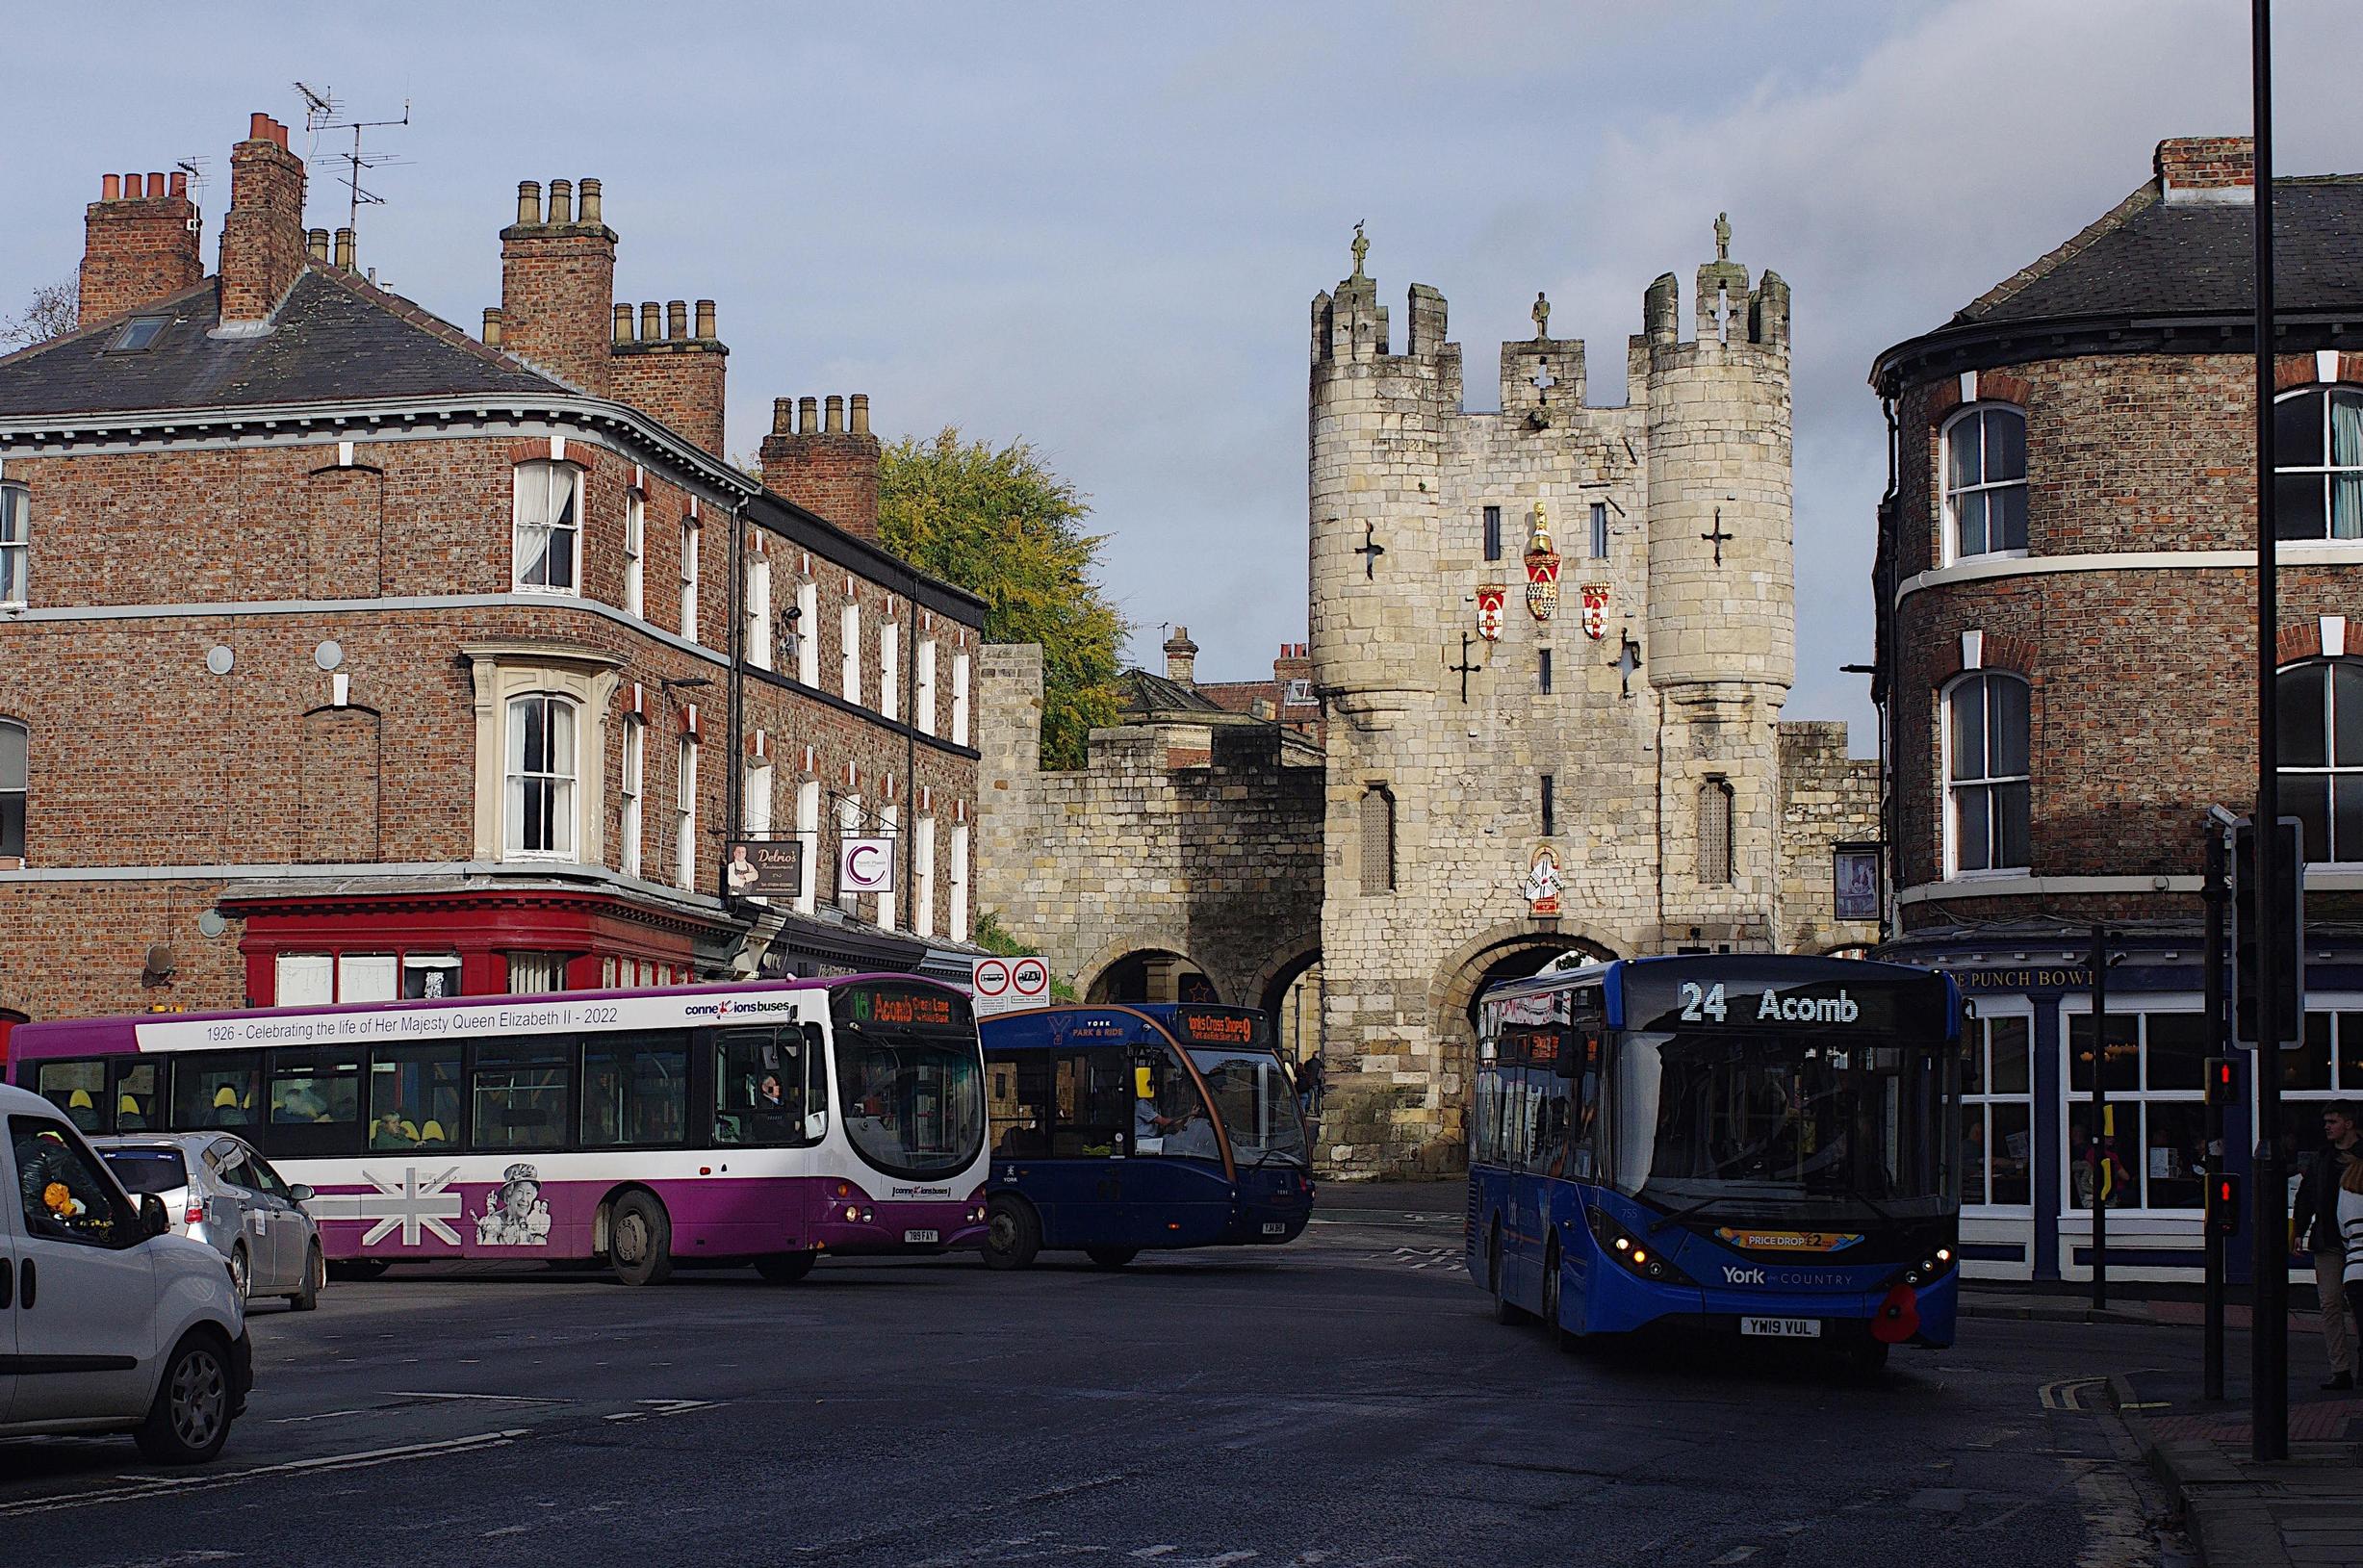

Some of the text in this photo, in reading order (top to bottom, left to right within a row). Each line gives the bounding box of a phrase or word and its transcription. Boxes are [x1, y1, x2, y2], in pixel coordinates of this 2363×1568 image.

[758, 848, 797, 862] Delrio's
[1971, 971, 2030, 987] PUNCH
[855, 991, 912, 1022] 16 Acomb
[1681, 982, 1859, 1022] 24 Acomb
[207, 1026, 235, 1041] 1926
[246, 1023, 313, 1041] Celebrating
[317, 1020, 336, 1036] the
[339, 1019, 356, 1034] life
[360, 1018, 372, 1033] of
[375, 1017, 398, 1033] Her
[401, 1015, 449, 1034] Majesty
[453, 1014, 495, 1029] Queen
[500, 1011, 559, 1027] Elizabeth
[563, 1010, 571, 1024] II
[584, 1008, 618, 1023] 2022
[1206, 1015, 1224, 1032] Cross
[1243, 1017, 1250, 1042] 9
[1073, 1028, 1123, 1037] PARK & RIDE
[910, 1231, 934, 1241] 789 FAY
[1749, 1235, 1776, 1246] PRICE
[1777, 1236, 1805, 1247] DROP
[1722, 1266, 1764, 1285] York
[1781, 1273, 1853, 1285] COUNTRY
[1750, 1319, 1811, 1335] YW19 VUL
